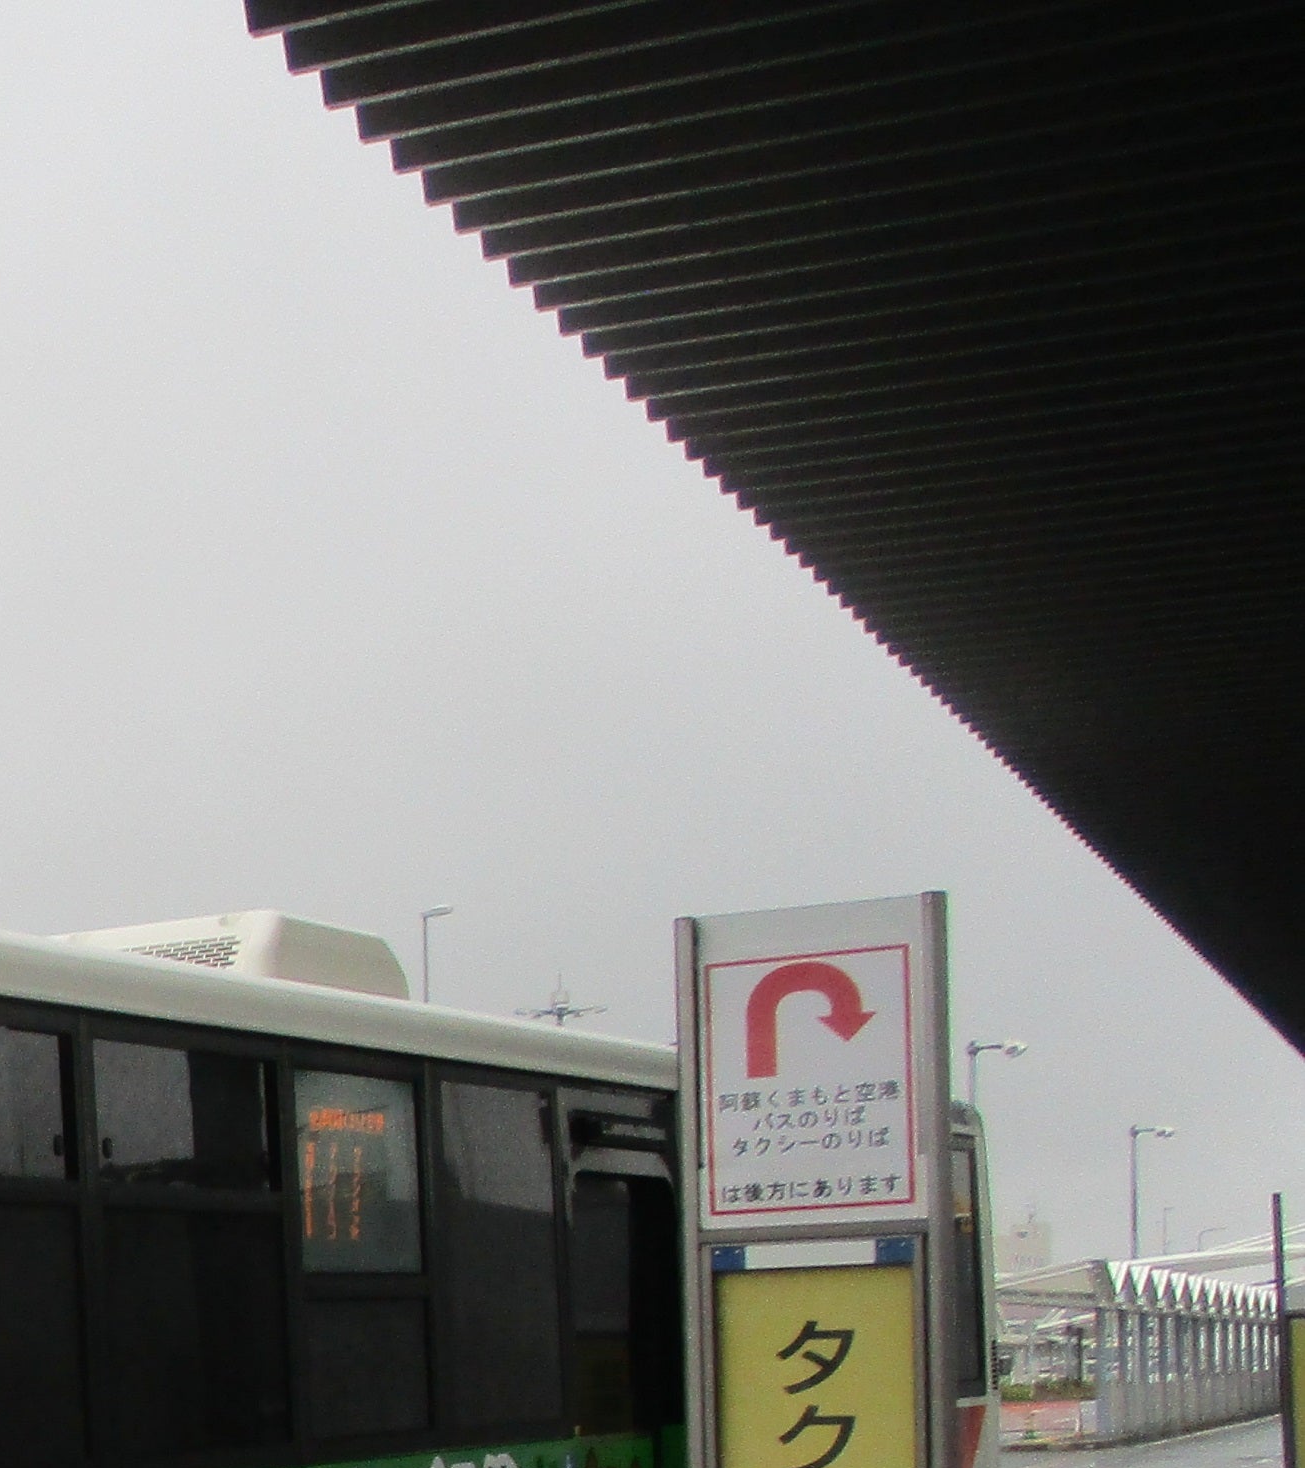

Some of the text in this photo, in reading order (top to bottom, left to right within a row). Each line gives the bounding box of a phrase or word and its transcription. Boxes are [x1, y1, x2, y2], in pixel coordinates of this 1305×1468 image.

[719, 1080, 900, 1112] 阿蘇くまもと空港
[753, 1106, 866, 1130] バスのりば
[732, 1127, 889, 1156] タクシーのりば
[721, 1173, 903, 1203] は後方にあります
